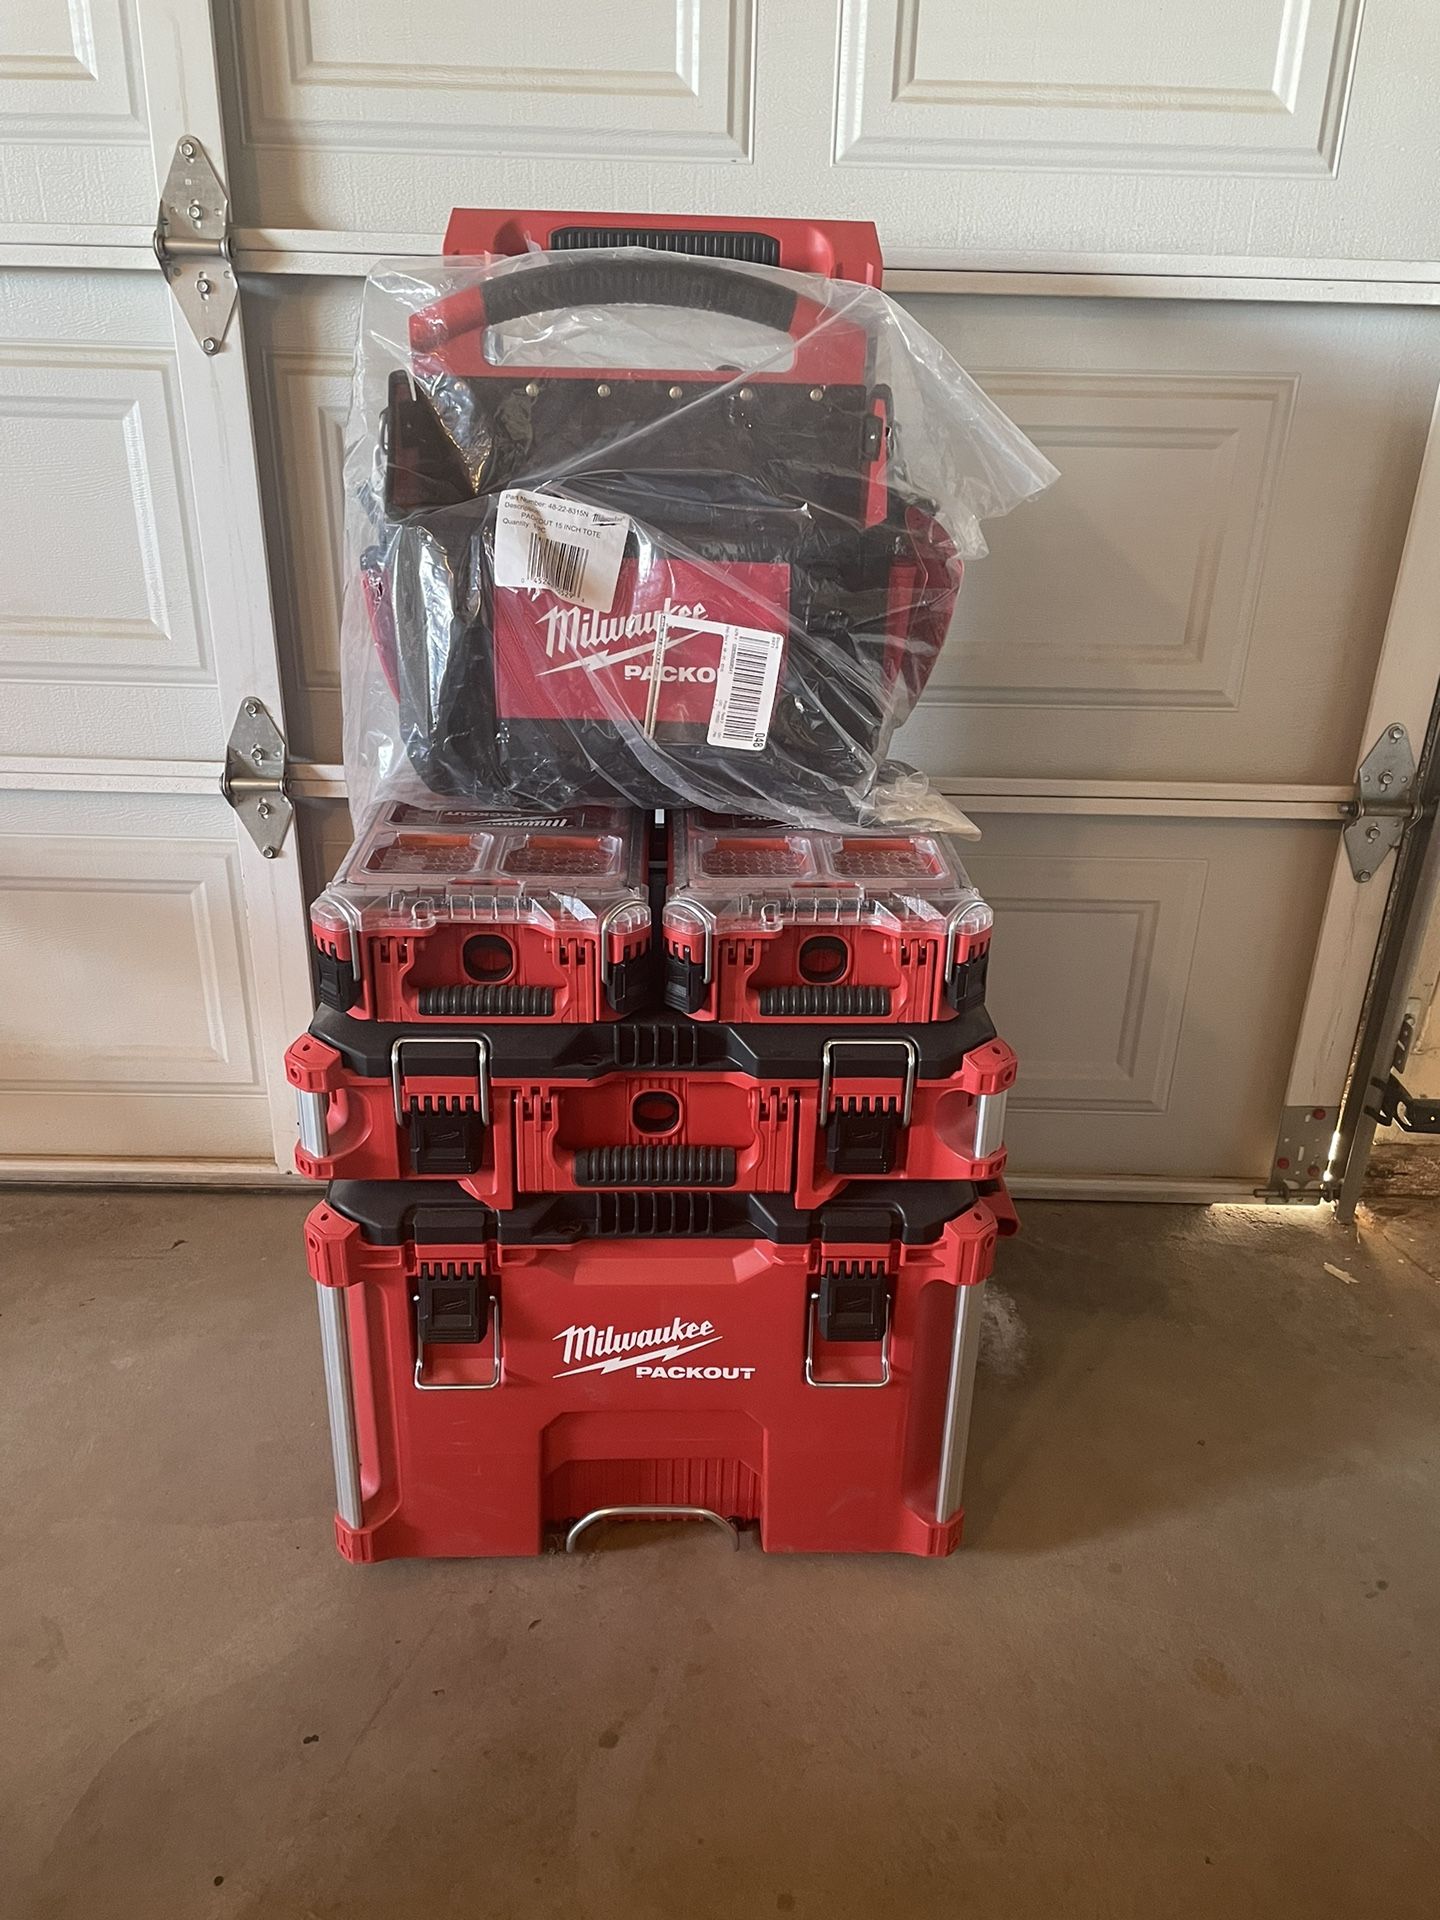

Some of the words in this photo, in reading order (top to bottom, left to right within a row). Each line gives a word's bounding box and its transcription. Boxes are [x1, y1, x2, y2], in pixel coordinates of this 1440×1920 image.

[563, 522, 581, 533] INCH
[582, 526, 601, 539] TOTE
[624, 665, 718, 684] PACKO
[753, 732, 766, 748] 048
[552, 1317, 715, 1364] Milwaukee
[635, 1366, 756, 1380] PACKOUT
